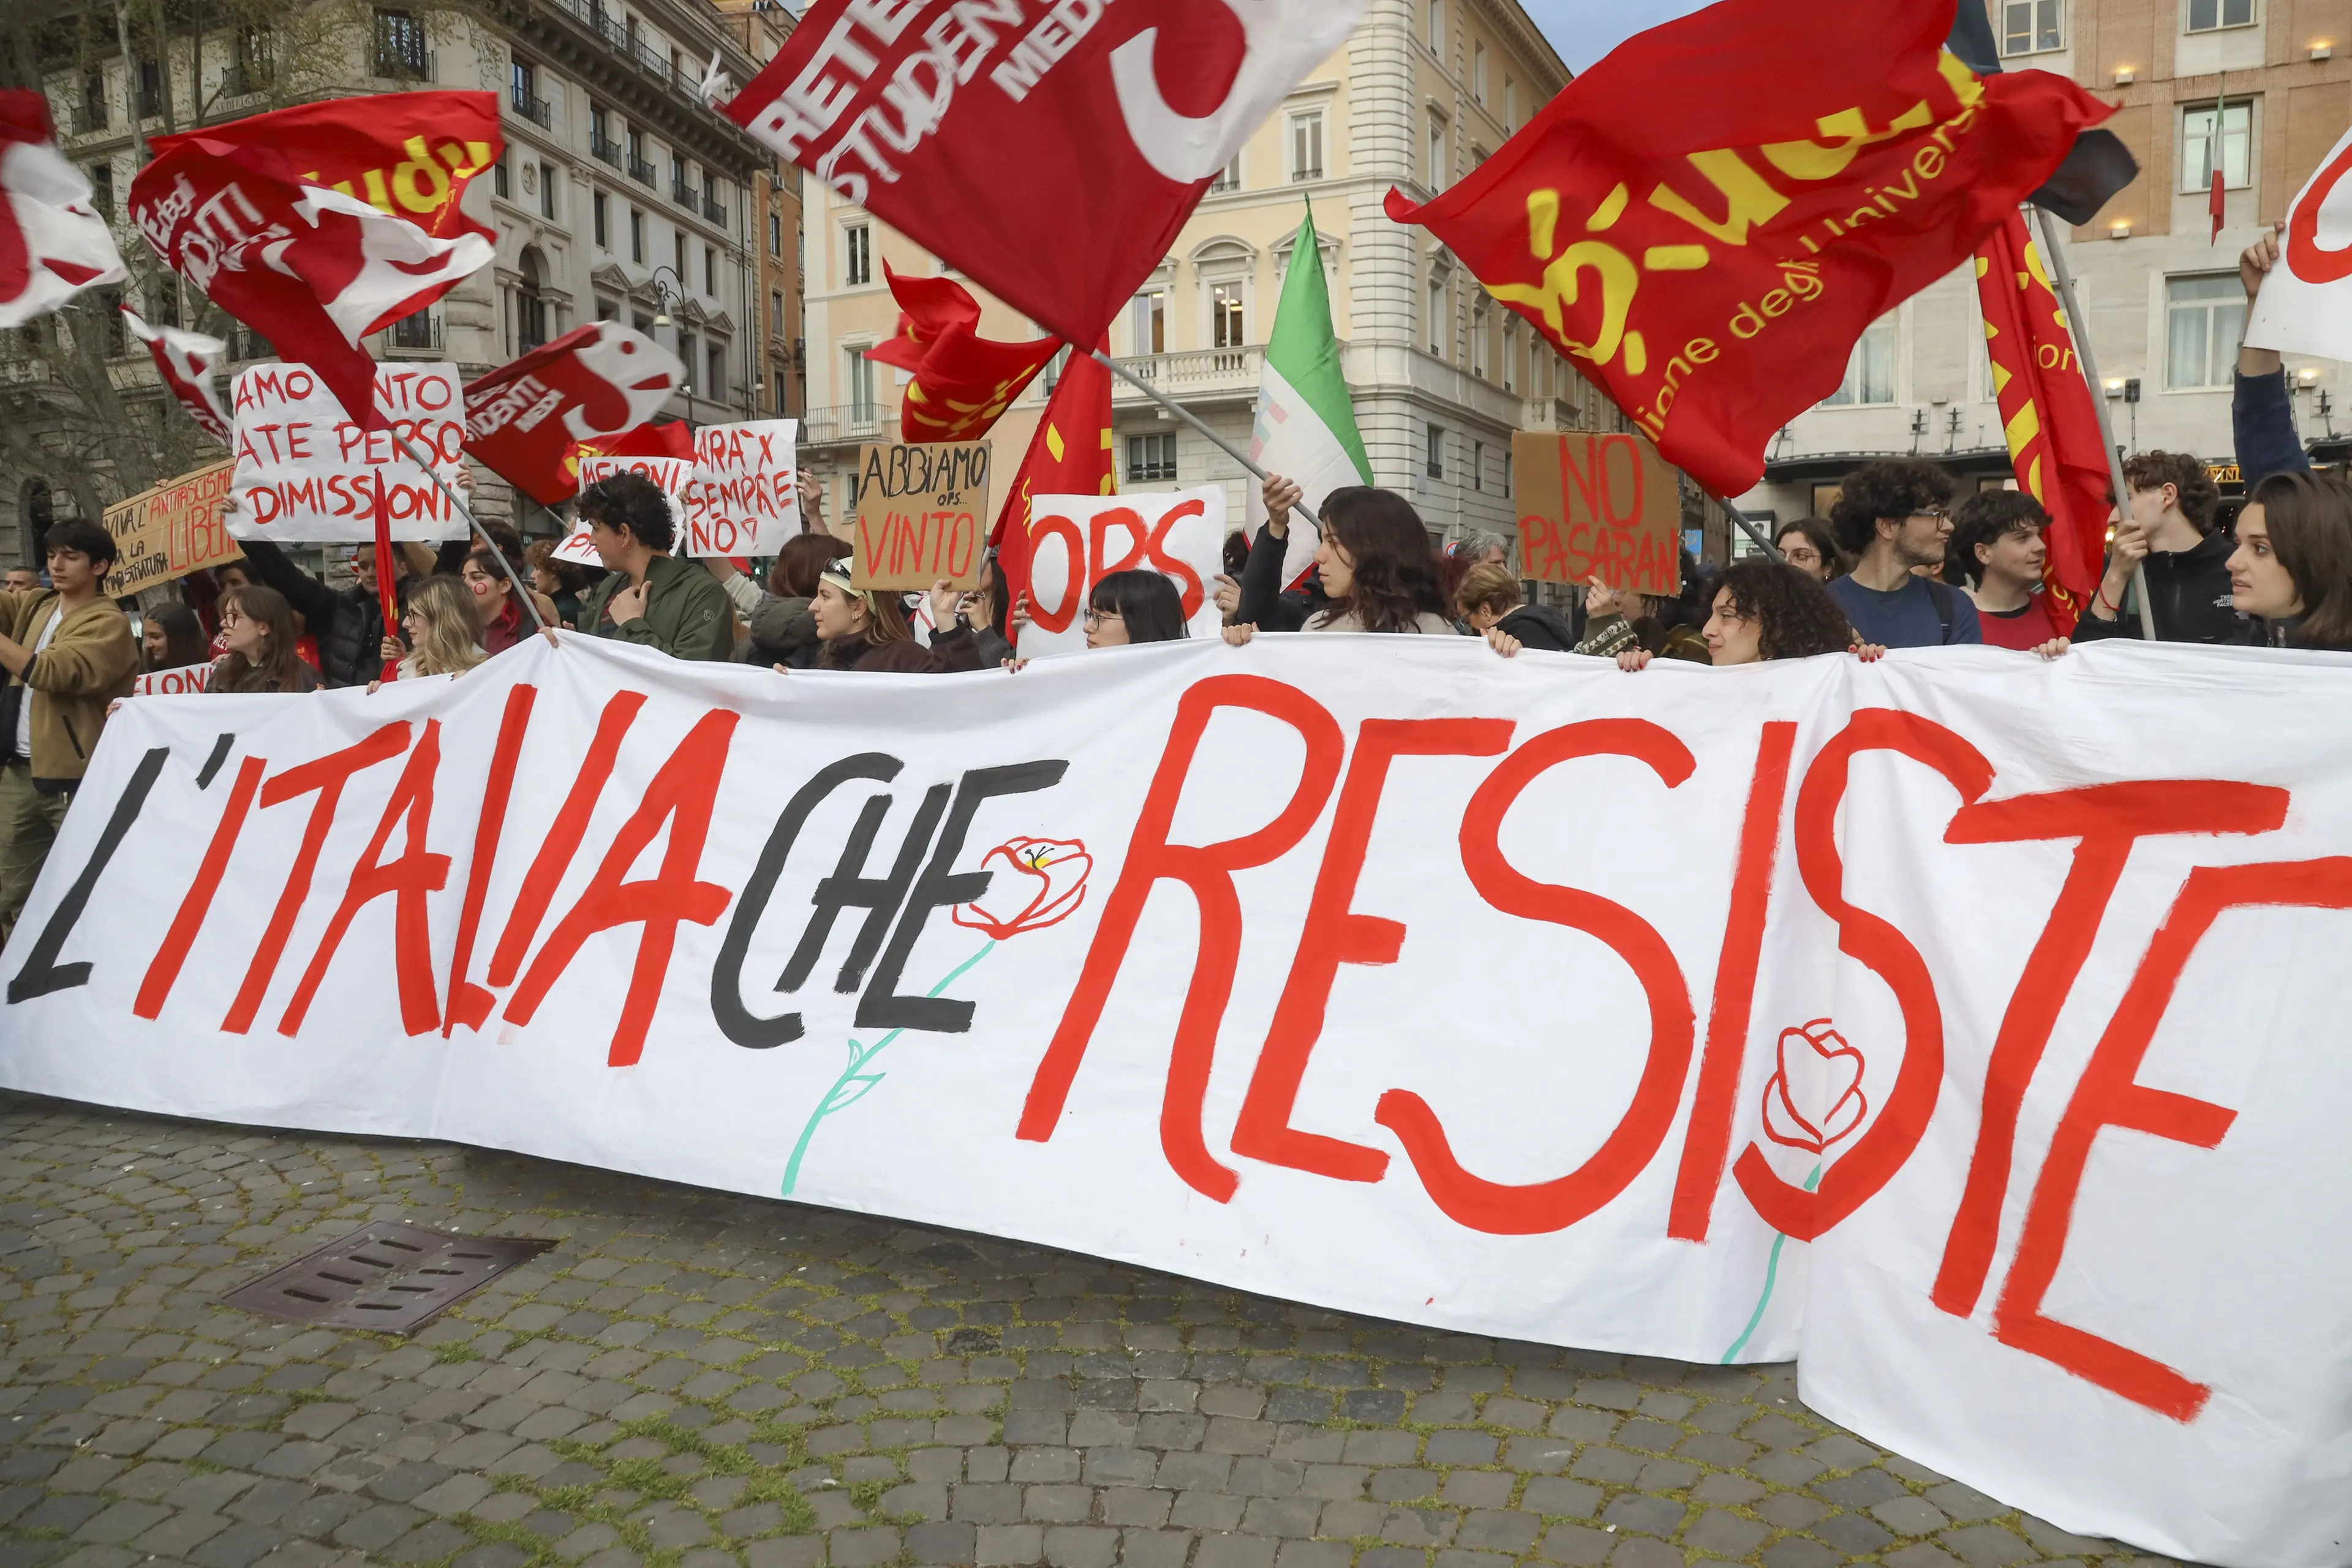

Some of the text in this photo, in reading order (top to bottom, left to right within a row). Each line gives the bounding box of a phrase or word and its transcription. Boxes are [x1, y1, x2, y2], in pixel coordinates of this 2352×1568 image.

[990, 0, 1104, 104] MED
[816, 0, 1025, 208] STUDEN
[235, 370, 314, 416] AMO
[372, 372, 452, 412] NTO
[235, 422, 314, 470] ATE
[333, 417, 466, 473] PERSO
[758, 431, 775, 473] X
[246, 475, 452, 524] DIMISSONI
[687, 470, 793, 521] SEMPRE
[1559, 434, 1645, 529] NO
[106, 507, 137, 538] VIVA
[130, 540, 144, 558] LA
[860, 511, 974, 578] VINTO
[1029, 499, 1205, 634] OPS
[1518, 514, 1678, 594] PASARAN
[710, 752, 1070, 1050] CHE
[1015, 673, 2352, 1423] RESISTE
